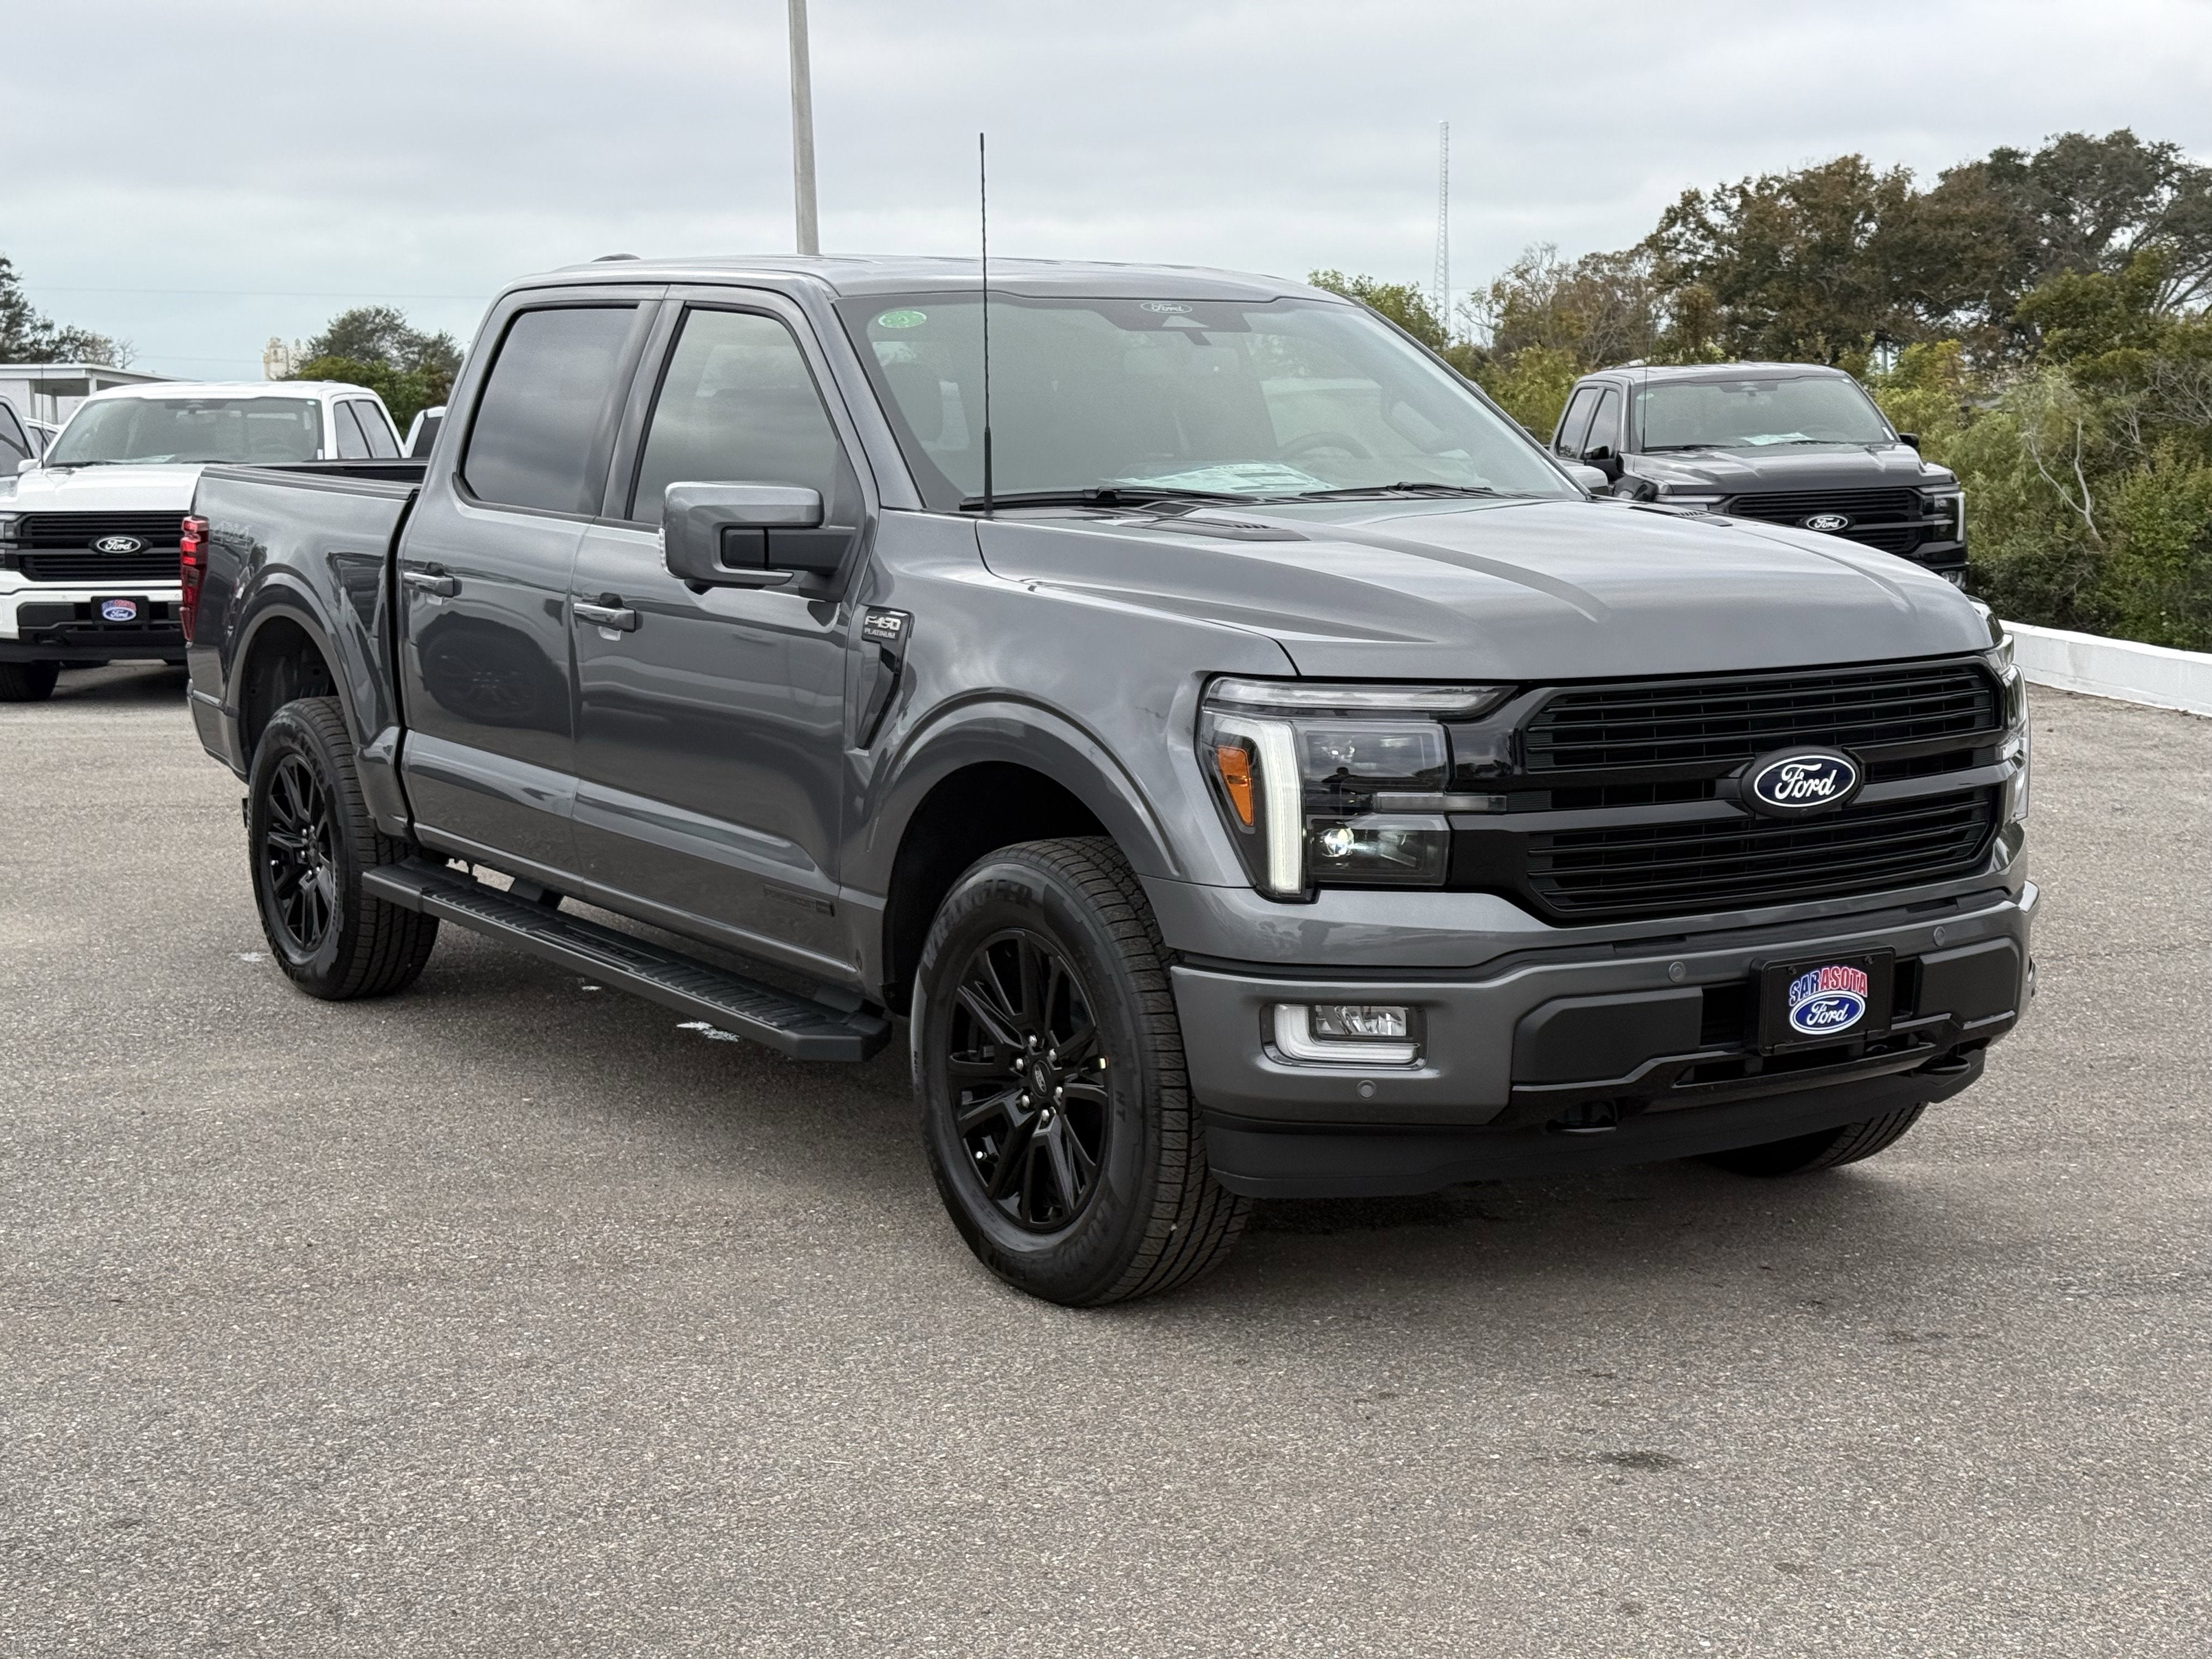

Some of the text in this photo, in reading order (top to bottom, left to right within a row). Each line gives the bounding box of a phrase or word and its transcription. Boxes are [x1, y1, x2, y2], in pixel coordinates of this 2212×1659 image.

[1152, 303, 1184, 312] Ford
[1815, 517, 1840, 528] Ford
[105, 539, 132, 550] Ford
[864, 628, 896, 639] PLATINUM
[1775, 763, 1837, 800] Ford
[1789, 966, 1868, 1007] SARASOTA
[1806, 1000, 1849, 1025] Ford
